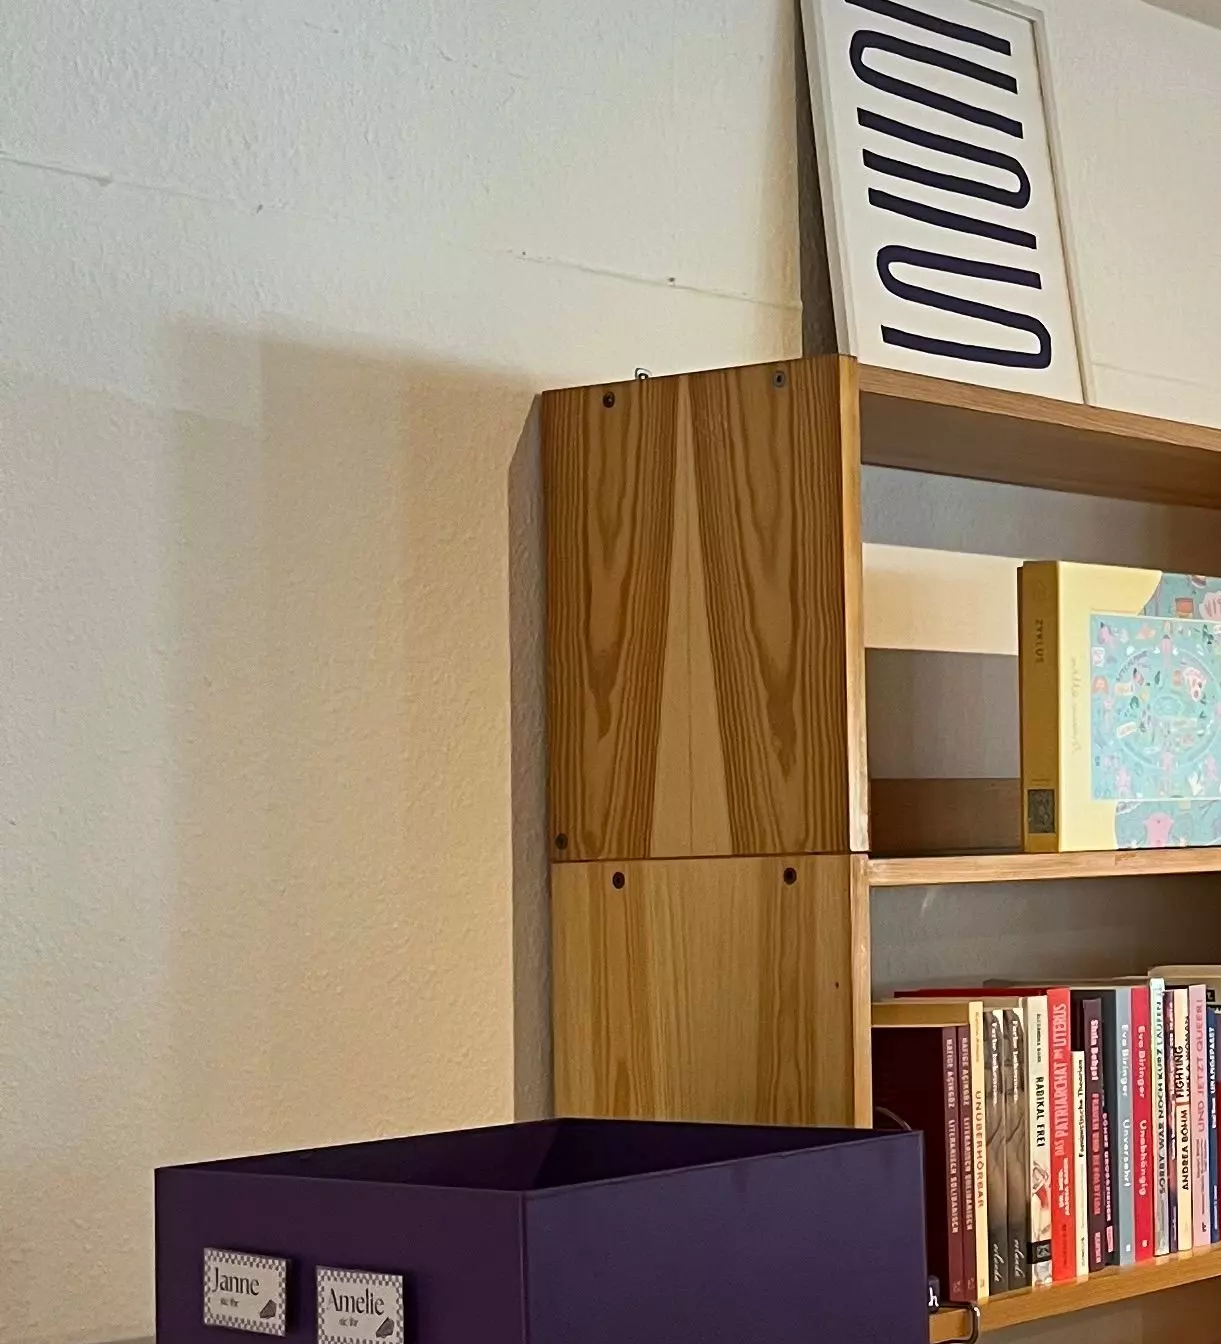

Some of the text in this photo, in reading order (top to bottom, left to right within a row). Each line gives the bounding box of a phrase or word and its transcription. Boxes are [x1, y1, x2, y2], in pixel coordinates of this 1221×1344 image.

[1052, 1003, 1067, 1047] UTERUS
[1121, 1024, 1129, 1097] Eva Biringer
[1137, 1025, 1147, 1098] Eva Biringer
[1156, 1050, 1164, 1079] KURZ
[1196, 1057, 1205, 1095] JETZT
[1035, 1076, 1046, 1147] RADIKAL FREI
[1053, 1062, 1069, 1134] PATRIARCHAT
[1156, 1083, 1165, 1117] NOCH
[1197, 1101, 1205, 1132] UND
[1122, 1119, 1131, 1187] Unversehrt
[1138, 1120, 1149, 1196] Unabhängig
[1180, 1145, 1190, 1190] ANDREA
[211, 1266, 260, 1296] Janne
[327, 1288, 385, 1316] Amelie
